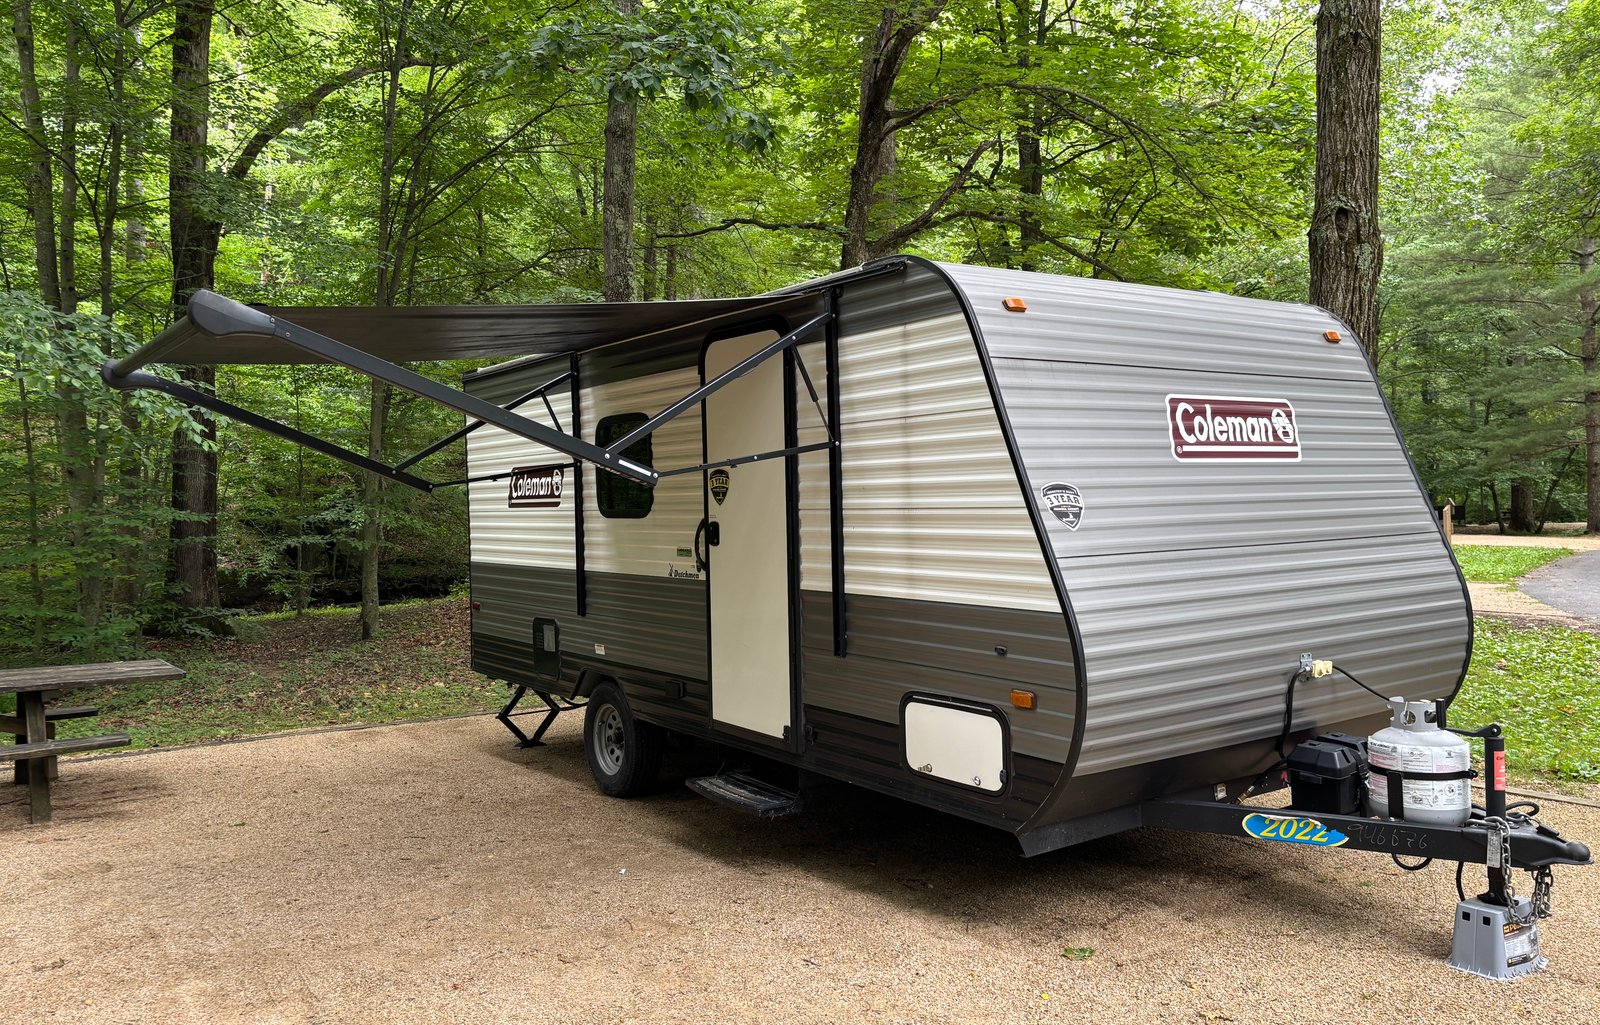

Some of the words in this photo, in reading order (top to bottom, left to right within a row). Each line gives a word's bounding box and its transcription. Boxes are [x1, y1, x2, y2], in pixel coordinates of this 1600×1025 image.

[1176, 402, 1274, 443] Coleman
[511, 473, 552, 498] Coleman
[715, 477, 728, 486] YEAR
[1046, 497, 1054, 505] 3
[1054, 494, 1081, 505] YEAR
[674, 570, 700, 579] Dutchmen
